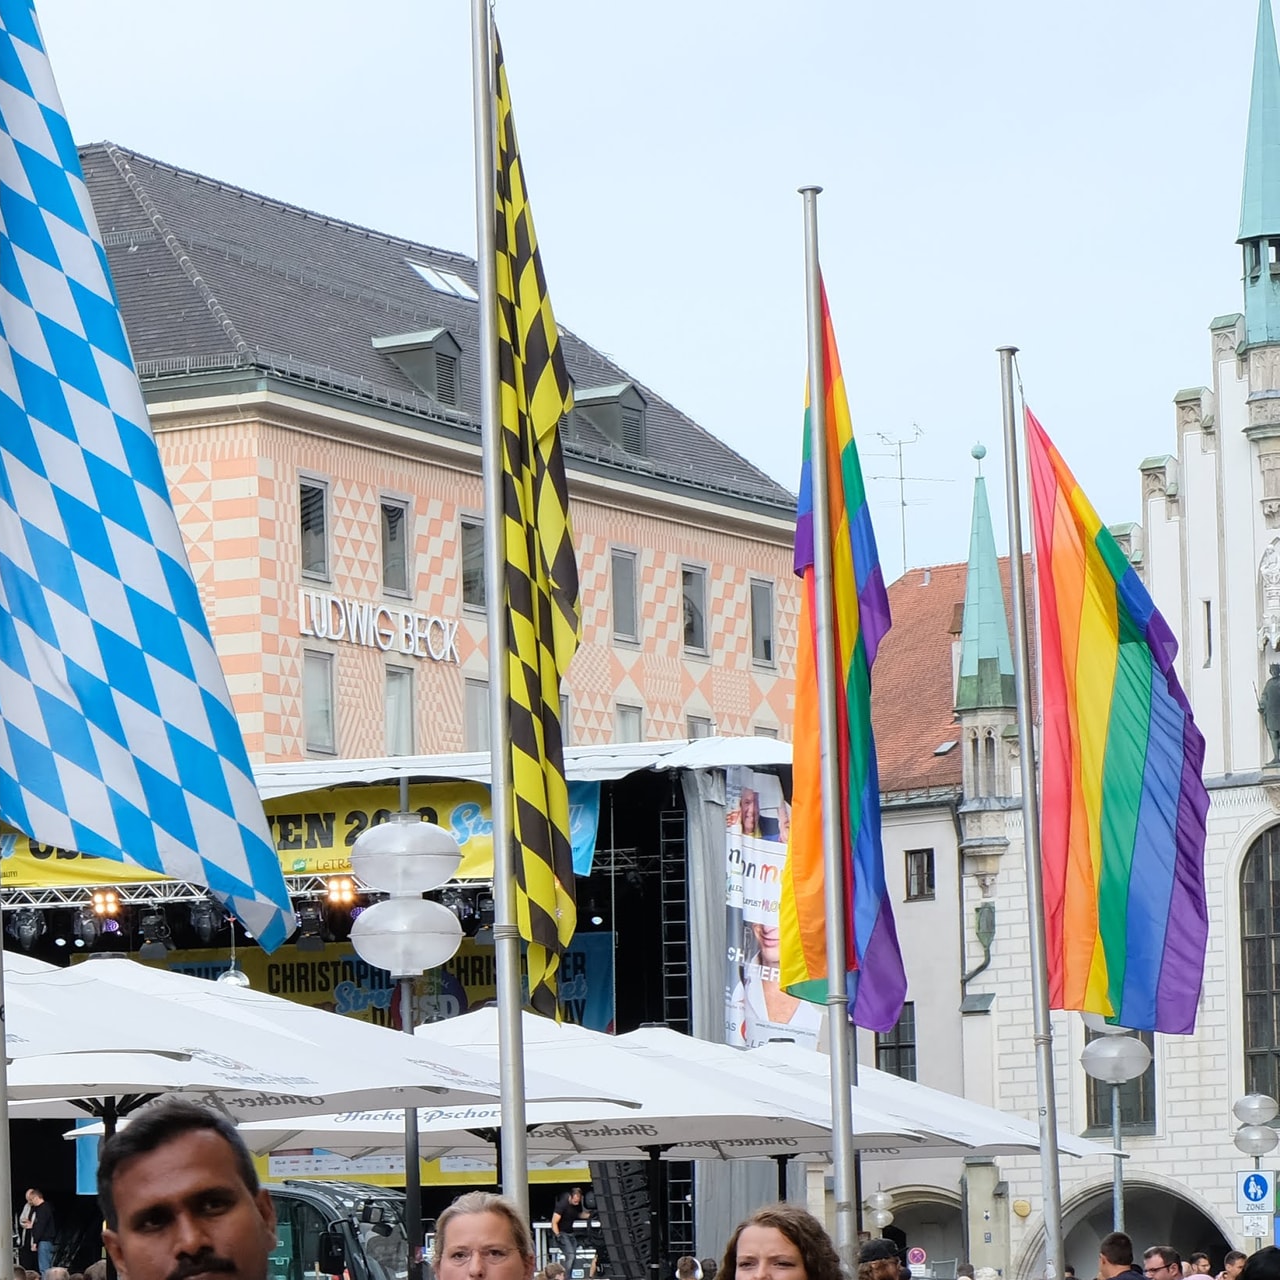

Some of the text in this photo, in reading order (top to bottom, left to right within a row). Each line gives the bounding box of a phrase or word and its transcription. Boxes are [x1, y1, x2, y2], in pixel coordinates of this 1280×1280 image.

[298, 589, 460, 665] LUDWIG BECK
[1246, 1203, 1265, 1211] ZONE
